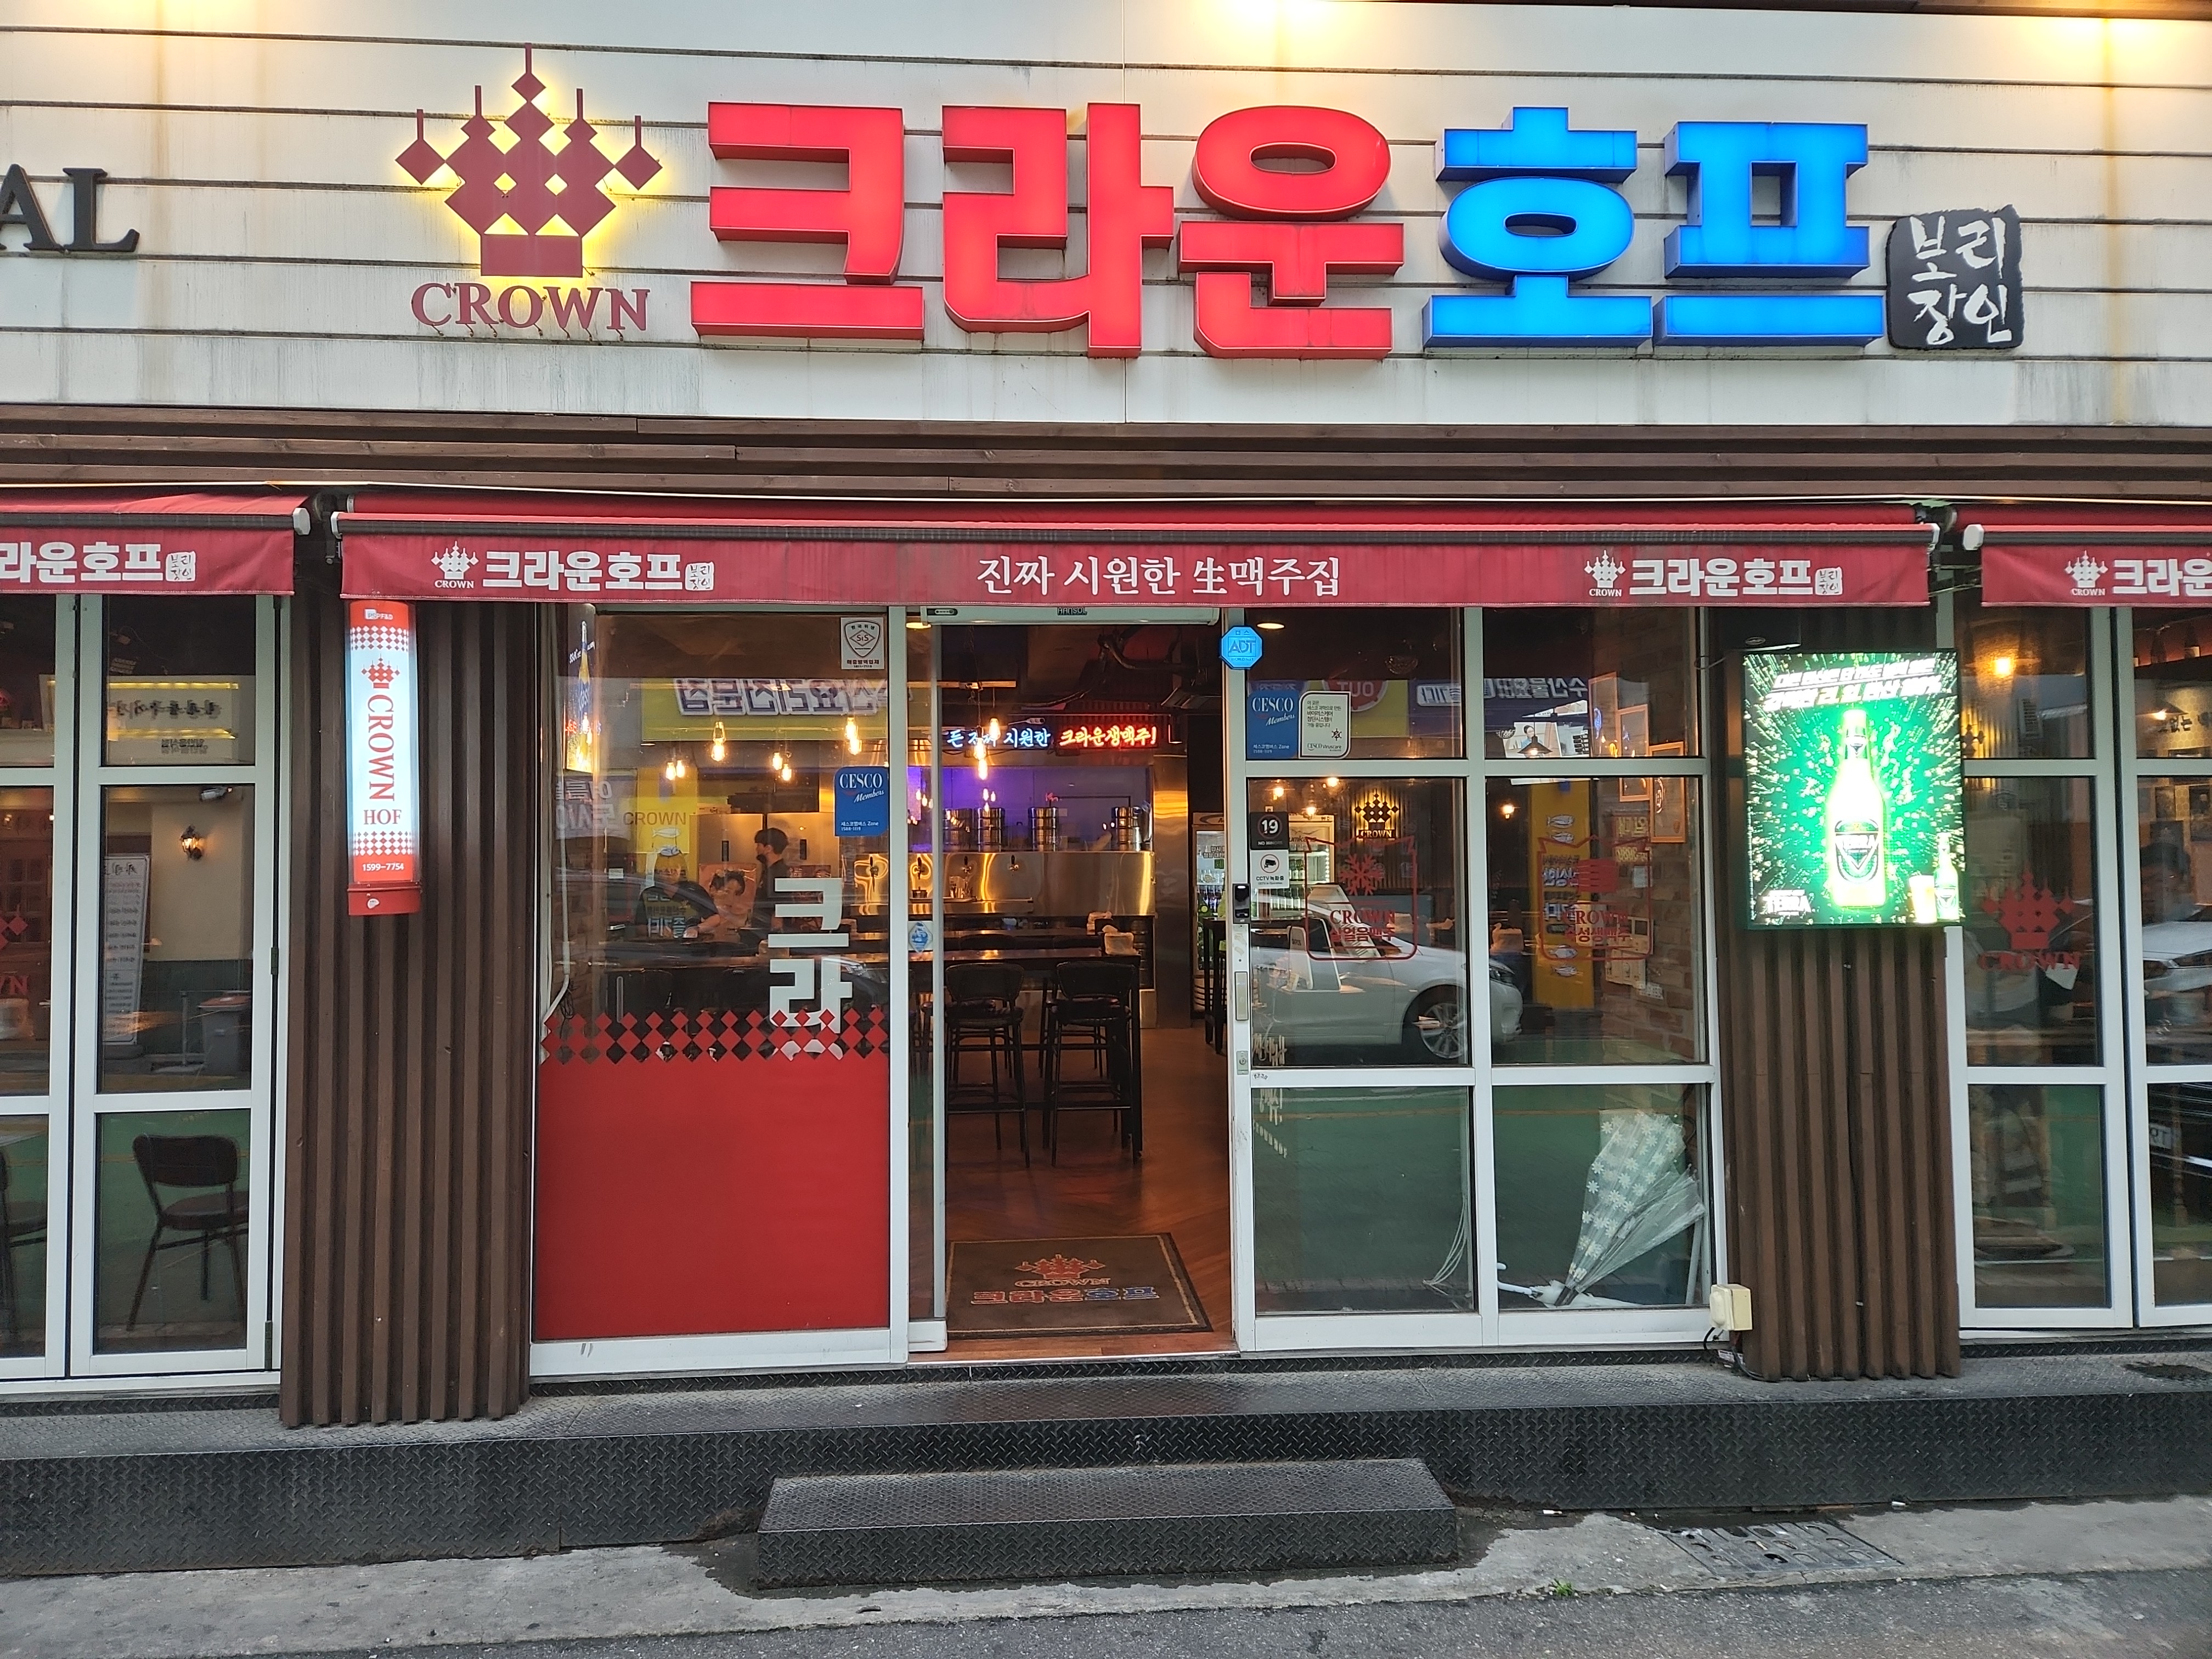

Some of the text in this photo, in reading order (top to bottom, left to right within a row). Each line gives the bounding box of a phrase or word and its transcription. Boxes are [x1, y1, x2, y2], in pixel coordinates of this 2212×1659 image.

[690, 101, 1886, 360] 크라운호프
[1910, 215, 2006, 279] 보리
[411, 282, 650, 331] CROWN
[1907, 283, 2012, 345] 장인
[482, 550, 684, 591] 크라운호프
[690, 564, 712, 578] 보리
[977, 555, 1340, 597] 진짜 시원한 生맥주집
[1629, 557, 1814, 597] 크라운호프
[1819, 569, 1839, 582] 보리
[434, 579, 475, 589] CROWN
[689, 578, 712, 590] 장인
[1819, 583, 1839, 595] 장인
[1589, 588, 1623, 597] CROWN
[2072, 588, 2106, 596] CROWN
[1057, 607, 1087, 616] HANSOL
[1229, 640, 1256, 653] ADT
[1252, 697, 1294, 712] CESCO
[1265, 713, 1295, 726] Members
[1003, 727, 1051, 748] 시원한
[1059, 725, 1158, 748] 크라운생맥주!
[367, 694, 395, 802] CROWN
[839, 773, 883, 788] CESCO
[854, 788, 884, 803] Members
[363, 809, 402, 826] HOF
[623, 811, 686, 825] CROWN
[1261, 819, 1278, 834] 19
[1360, 830, 1393, 838] CROWN
[362, 862, 404, 872] 1599-7754
[1330, 909, 1396, 924] CROWN
[1977, 951, 2080, 970] CROWN
[1014, 1277, 1111, 1288] CROWN
[970, 1286, 1160, 1305] 크라운호프
